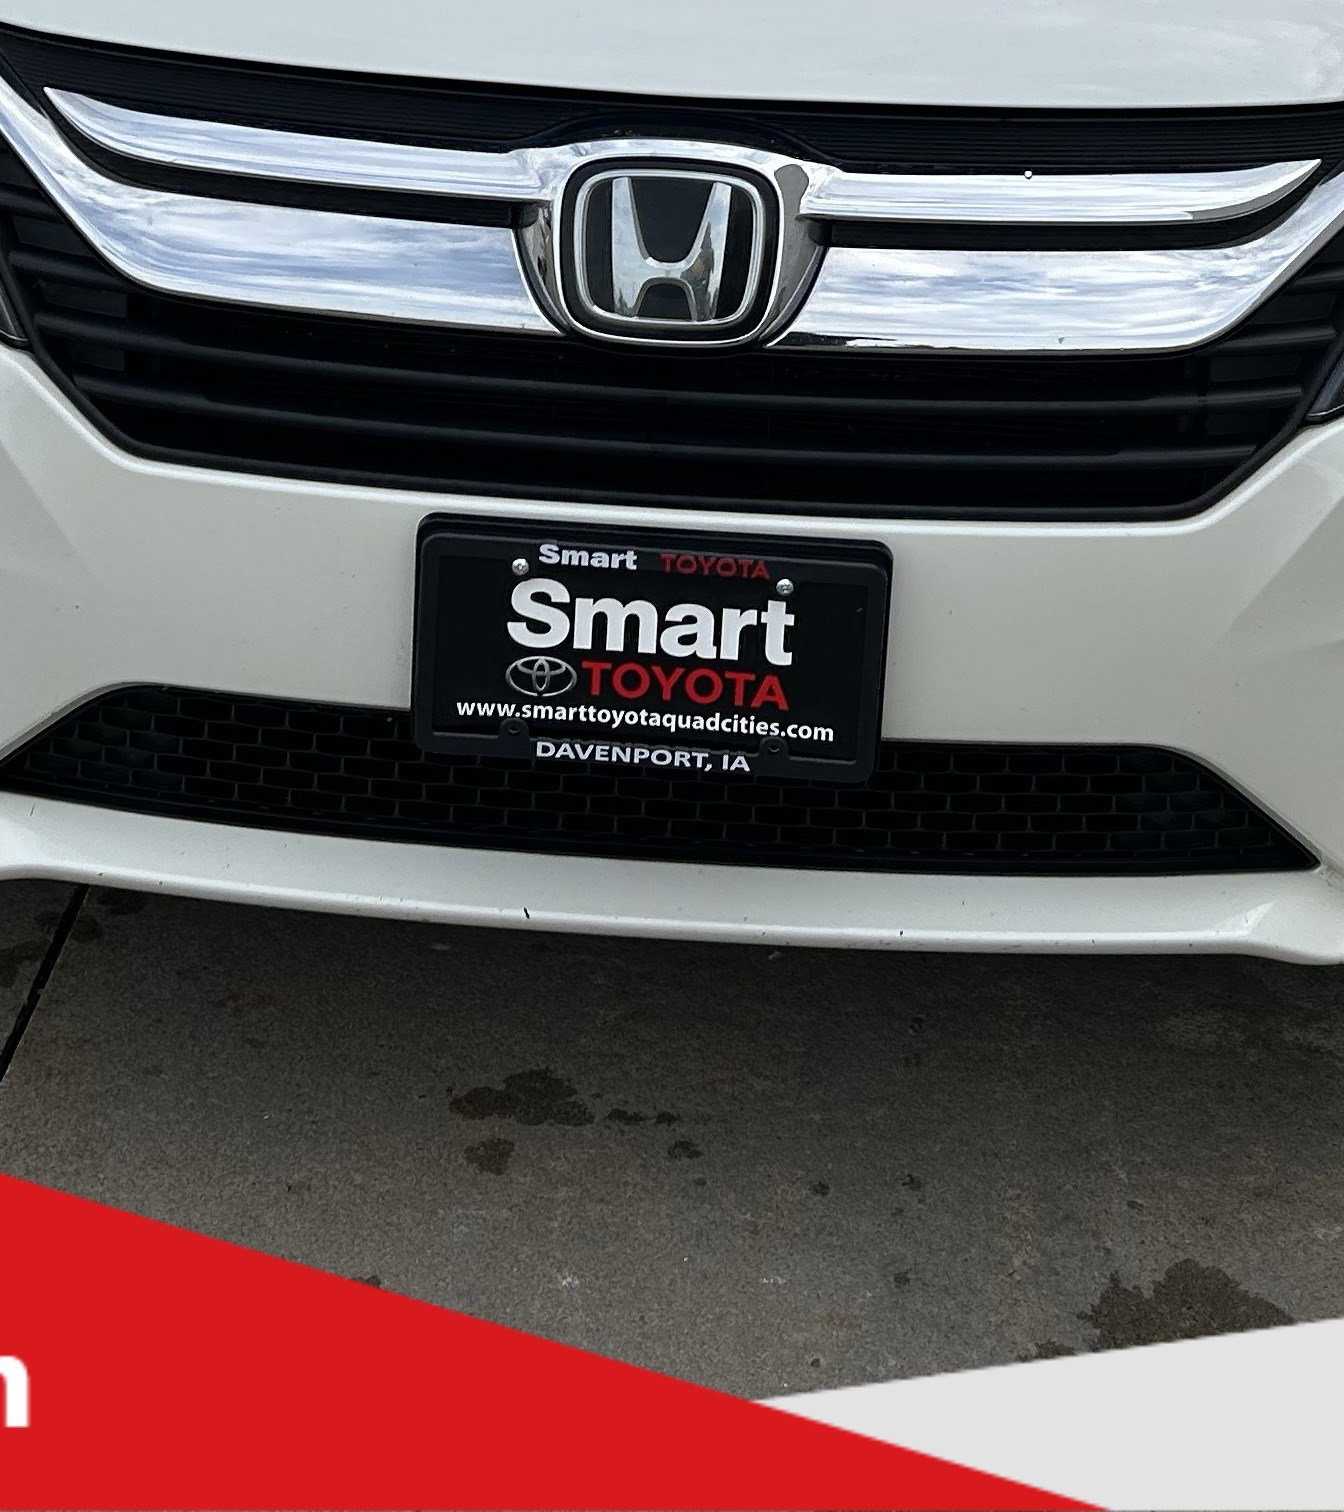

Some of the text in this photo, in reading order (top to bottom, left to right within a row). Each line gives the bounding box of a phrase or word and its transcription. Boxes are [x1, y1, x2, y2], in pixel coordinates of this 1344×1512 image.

[538, 543, 770, 579] Smart TOYOTA
[507, 577, 795, 666] Smart
[581, 660, 789, 711] TOYOTA
[456, 700, 834, 742] www.smarttoyotaquadcities.com
[536, 741, 751, 772] DAVENPORT, IA
